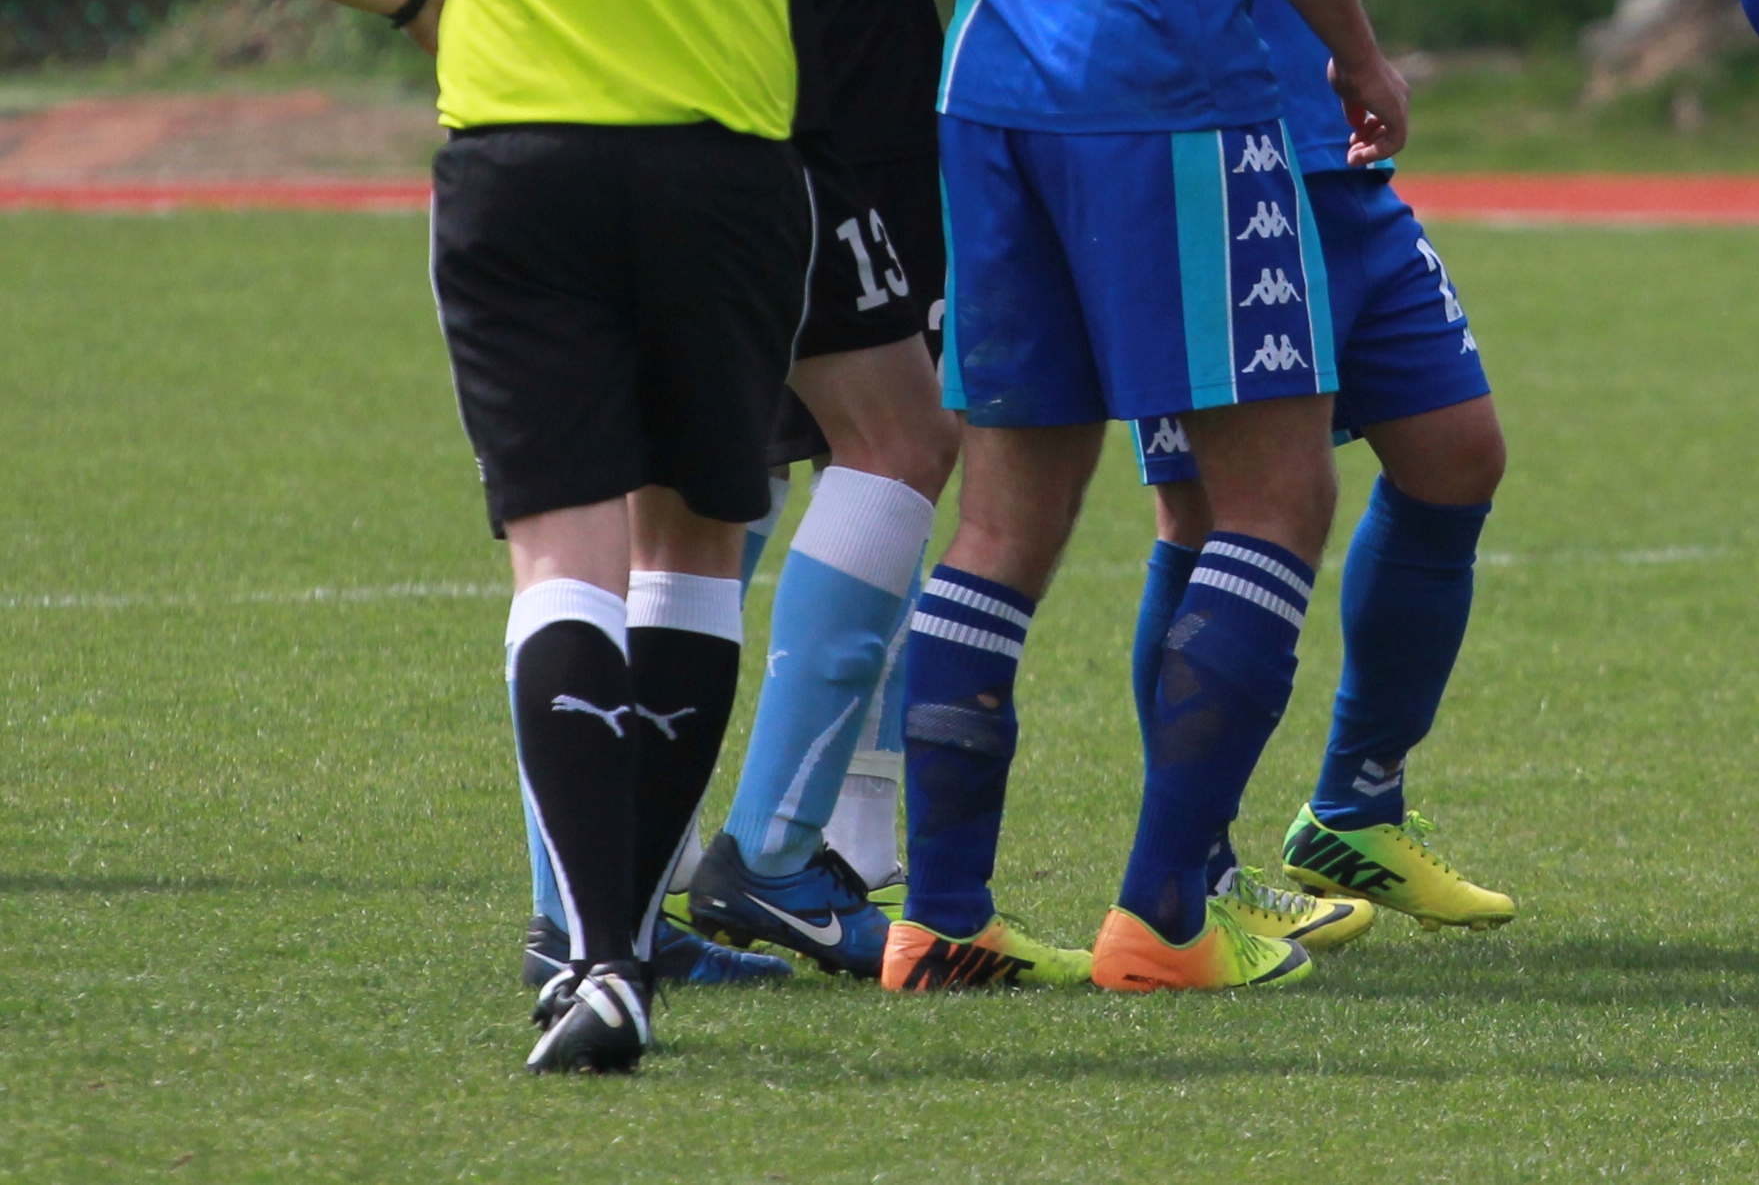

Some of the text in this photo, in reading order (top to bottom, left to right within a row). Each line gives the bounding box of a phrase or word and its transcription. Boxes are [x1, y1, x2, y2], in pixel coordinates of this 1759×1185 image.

[836, 208, 909, 311] 13
[1283, 822, 1407, 891] NIKE
[901, 937, 1036, 992] NIKE
